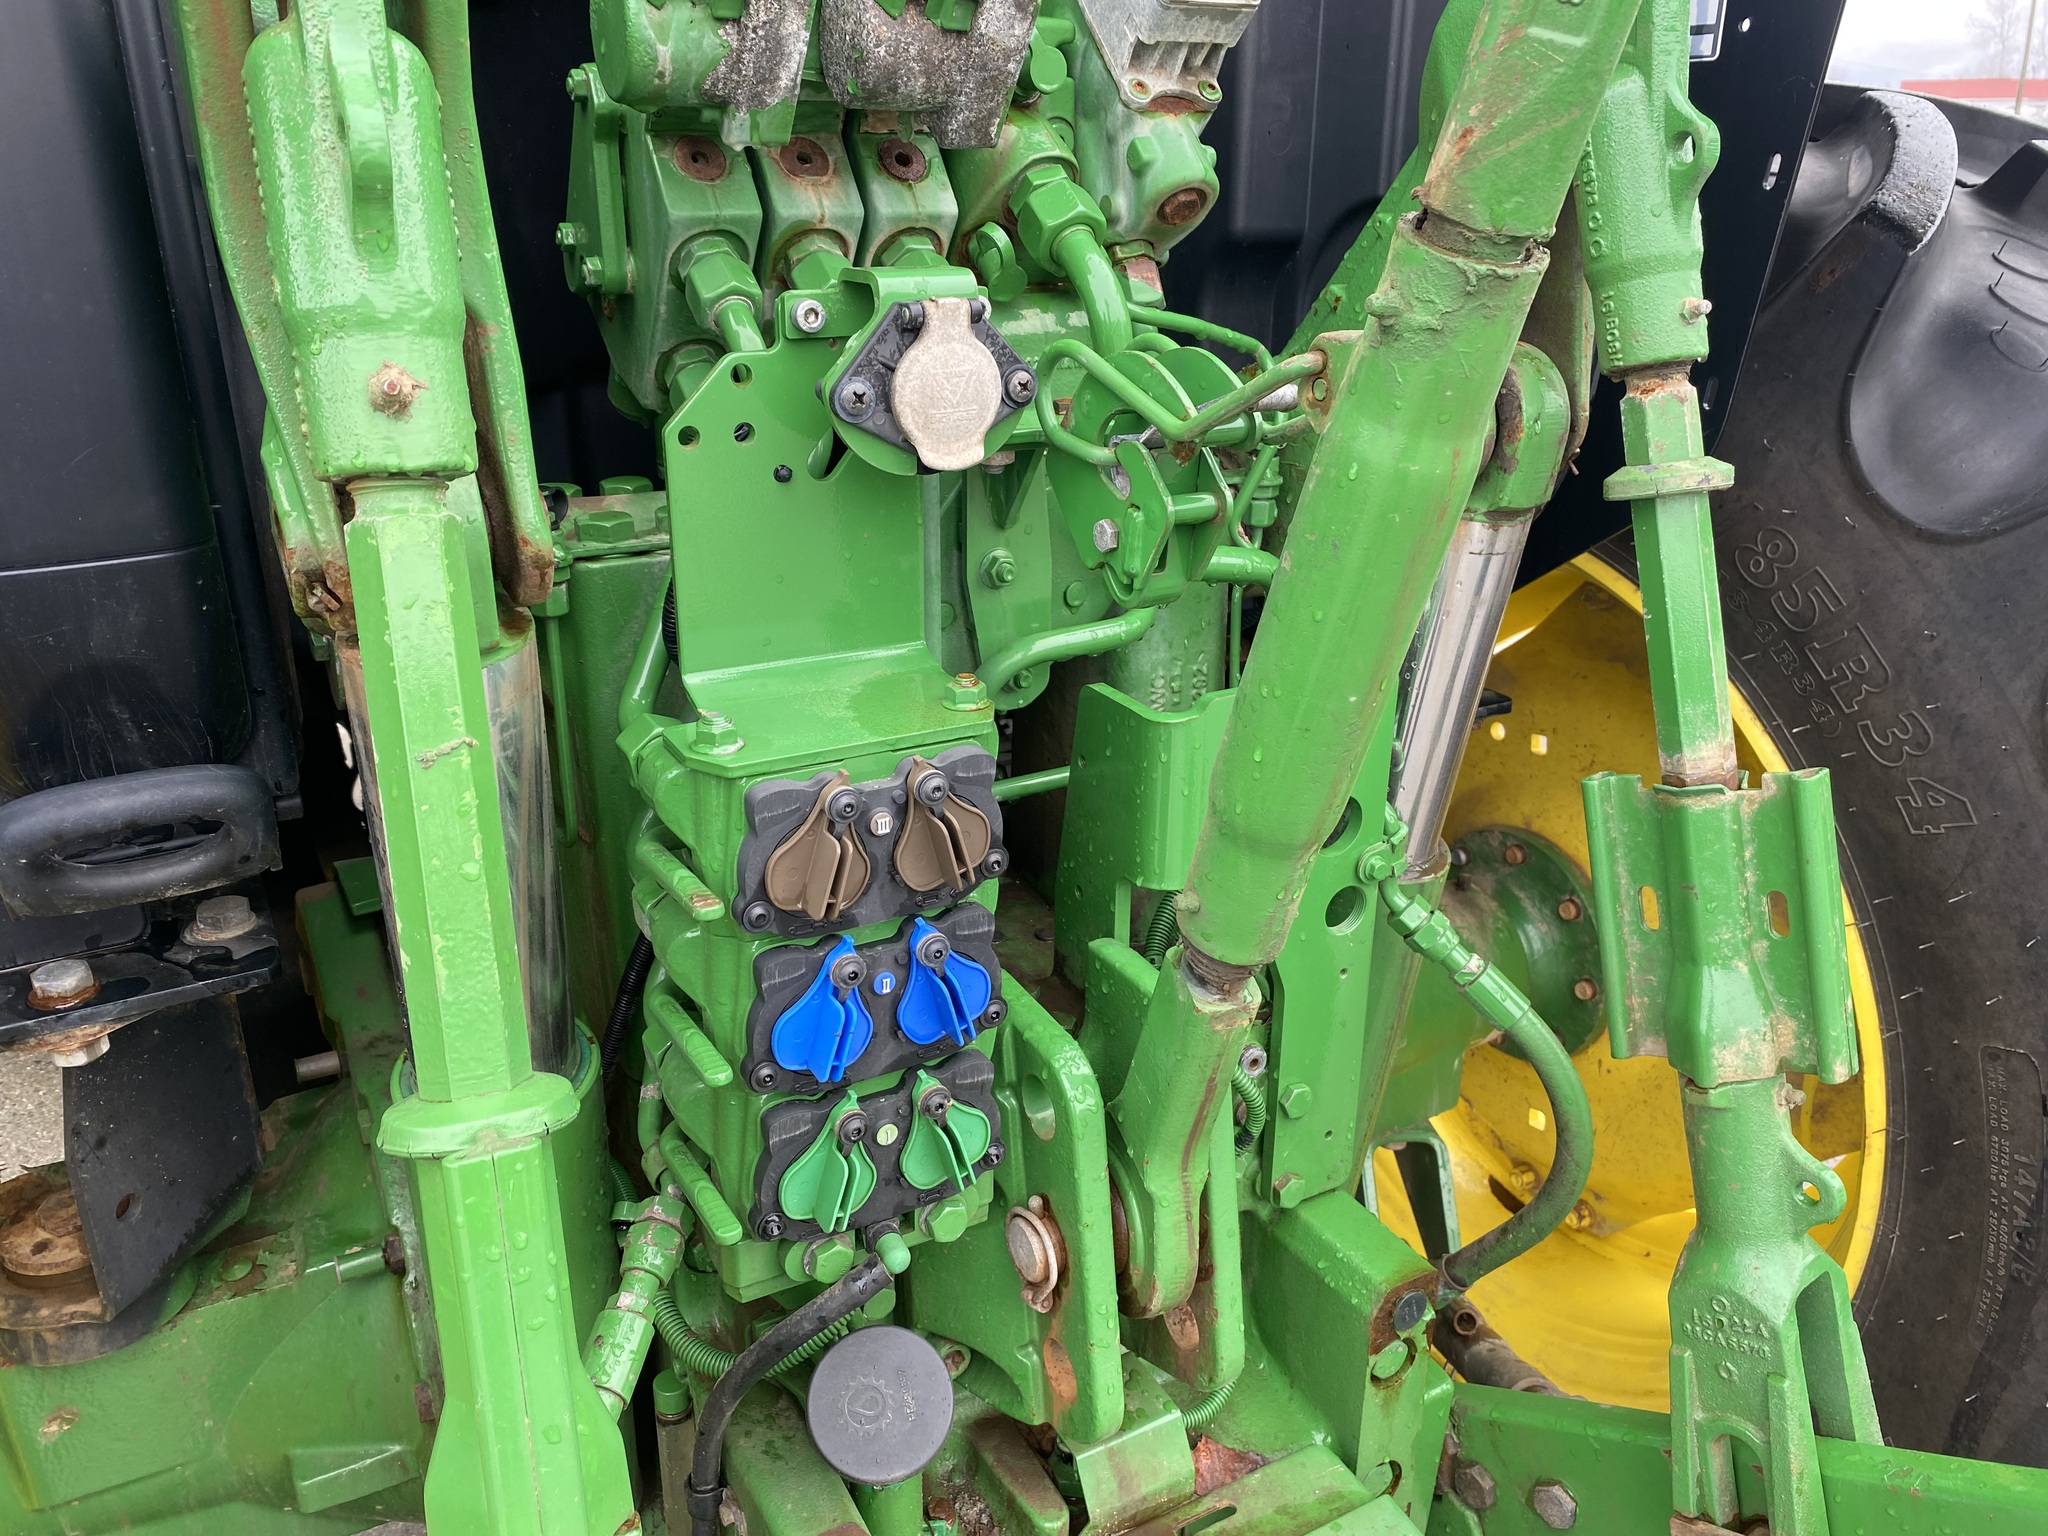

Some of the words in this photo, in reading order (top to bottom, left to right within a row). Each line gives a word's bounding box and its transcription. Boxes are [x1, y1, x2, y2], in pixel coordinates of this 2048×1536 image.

[876, 817, 891, 833] III
[881, 977, 891, 994] II
[1989, 1096, 1998, 1127] LOAD
[2000, 1100, 2009, 1131] LOAD
[1990, 1188, 1998, 1205] AT
[2001, 1195, 2009, 1213] AT
[1985, 1269, 1994, 1285] AT
[1995, 1284, 2004, 1300] AT
